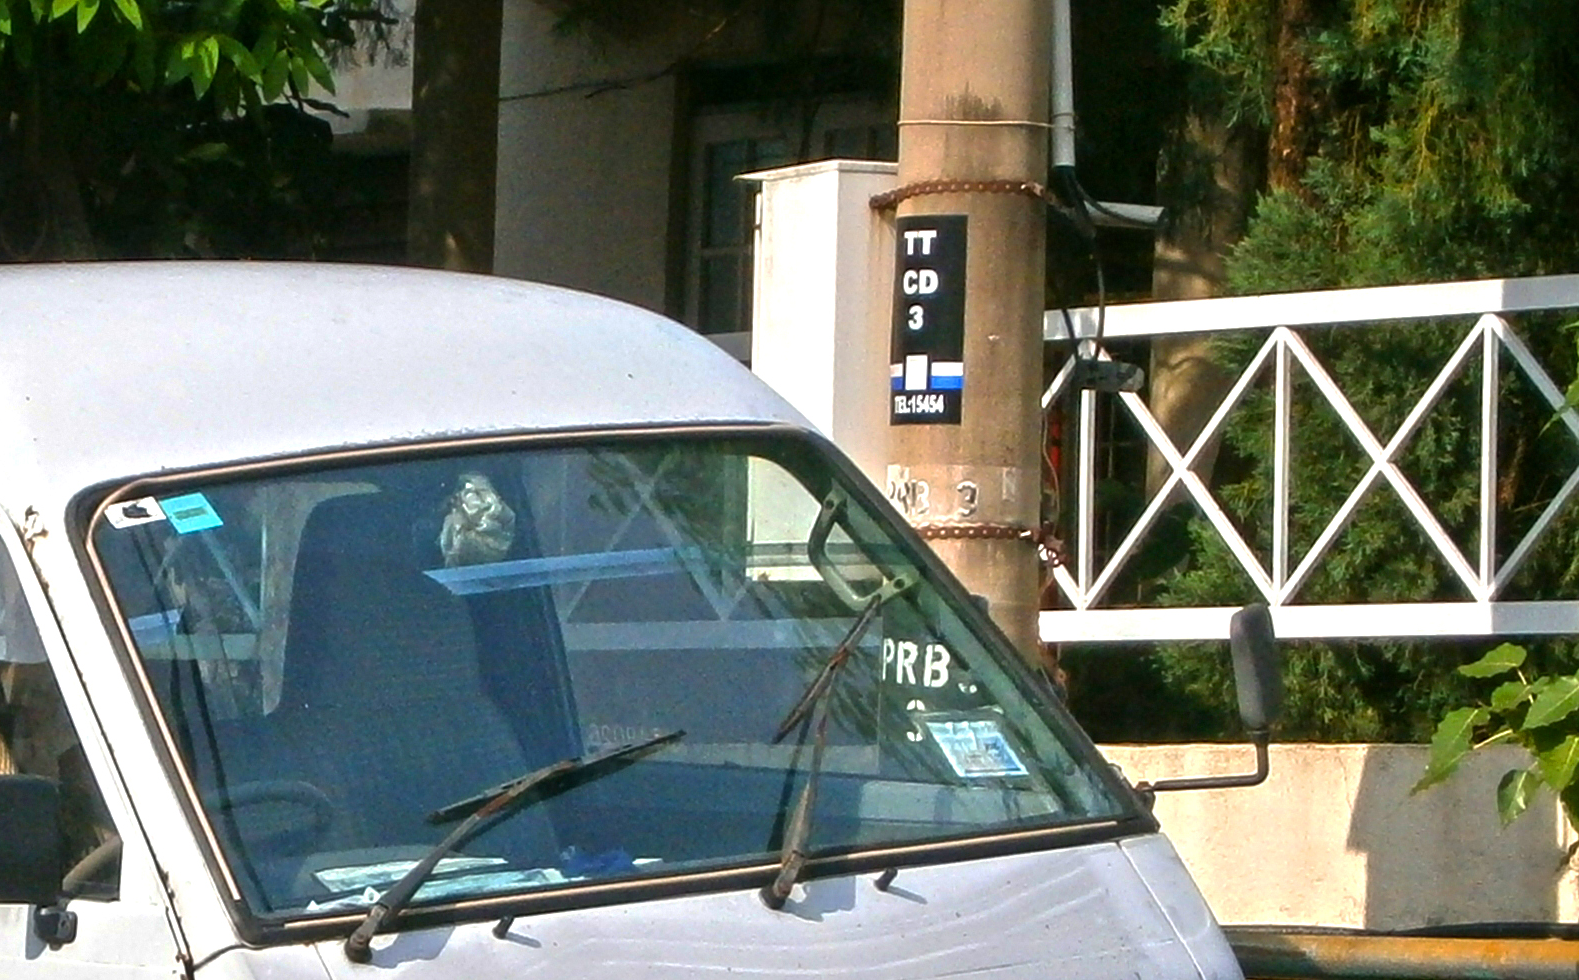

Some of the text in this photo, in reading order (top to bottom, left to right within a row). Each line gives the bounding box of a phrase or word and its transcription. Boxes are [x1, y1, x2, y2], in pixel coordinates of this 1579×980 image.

[903, 230, 937, 255] TT
[903, 269, 939, 294] CD
[908, 305, 924, 330] 3
